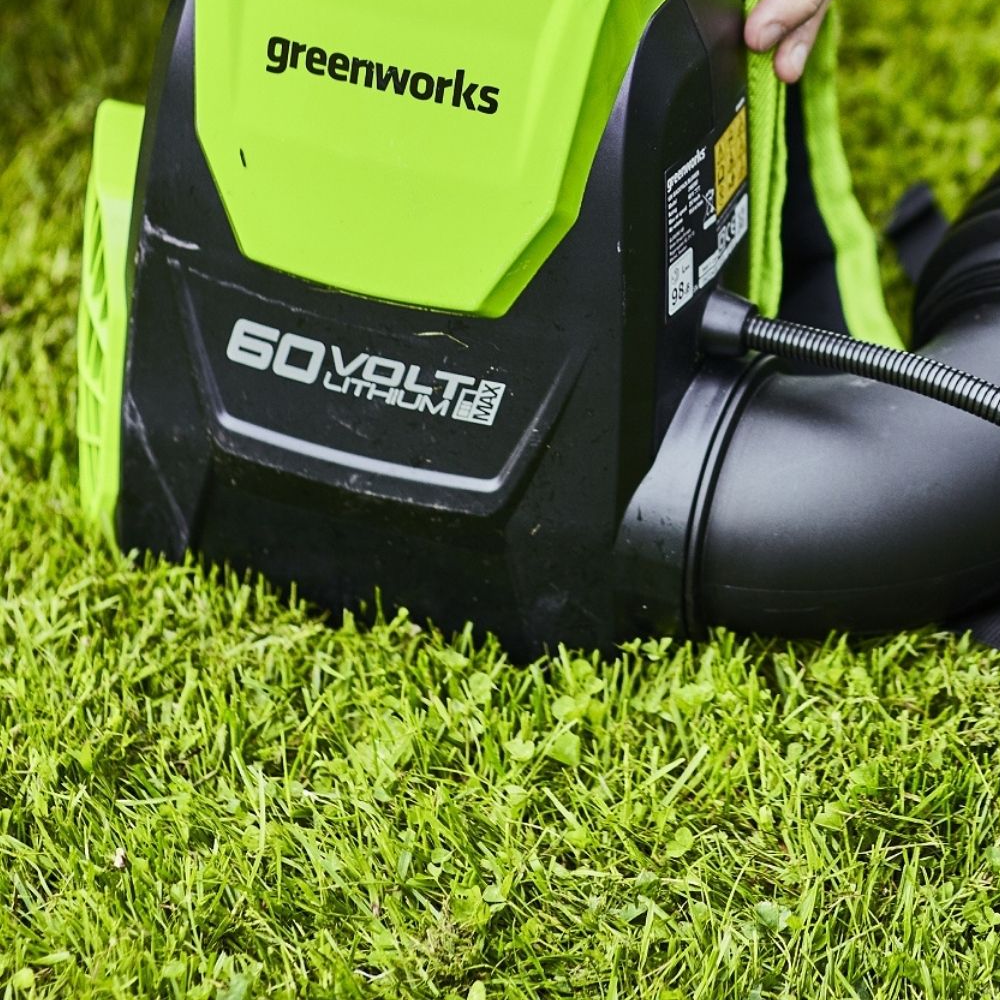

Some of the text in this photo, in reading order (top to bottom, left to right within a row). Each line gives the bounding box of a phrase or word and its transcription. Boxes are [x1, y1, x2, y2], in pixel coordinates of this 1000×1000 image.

[266, 36, 500, 115] greenworks
[666, 148, 706, 193] greenworks
[226, 318, 476, 400] 60 VOLT
[323, 371, 503, 422] LITHIUM MAX
